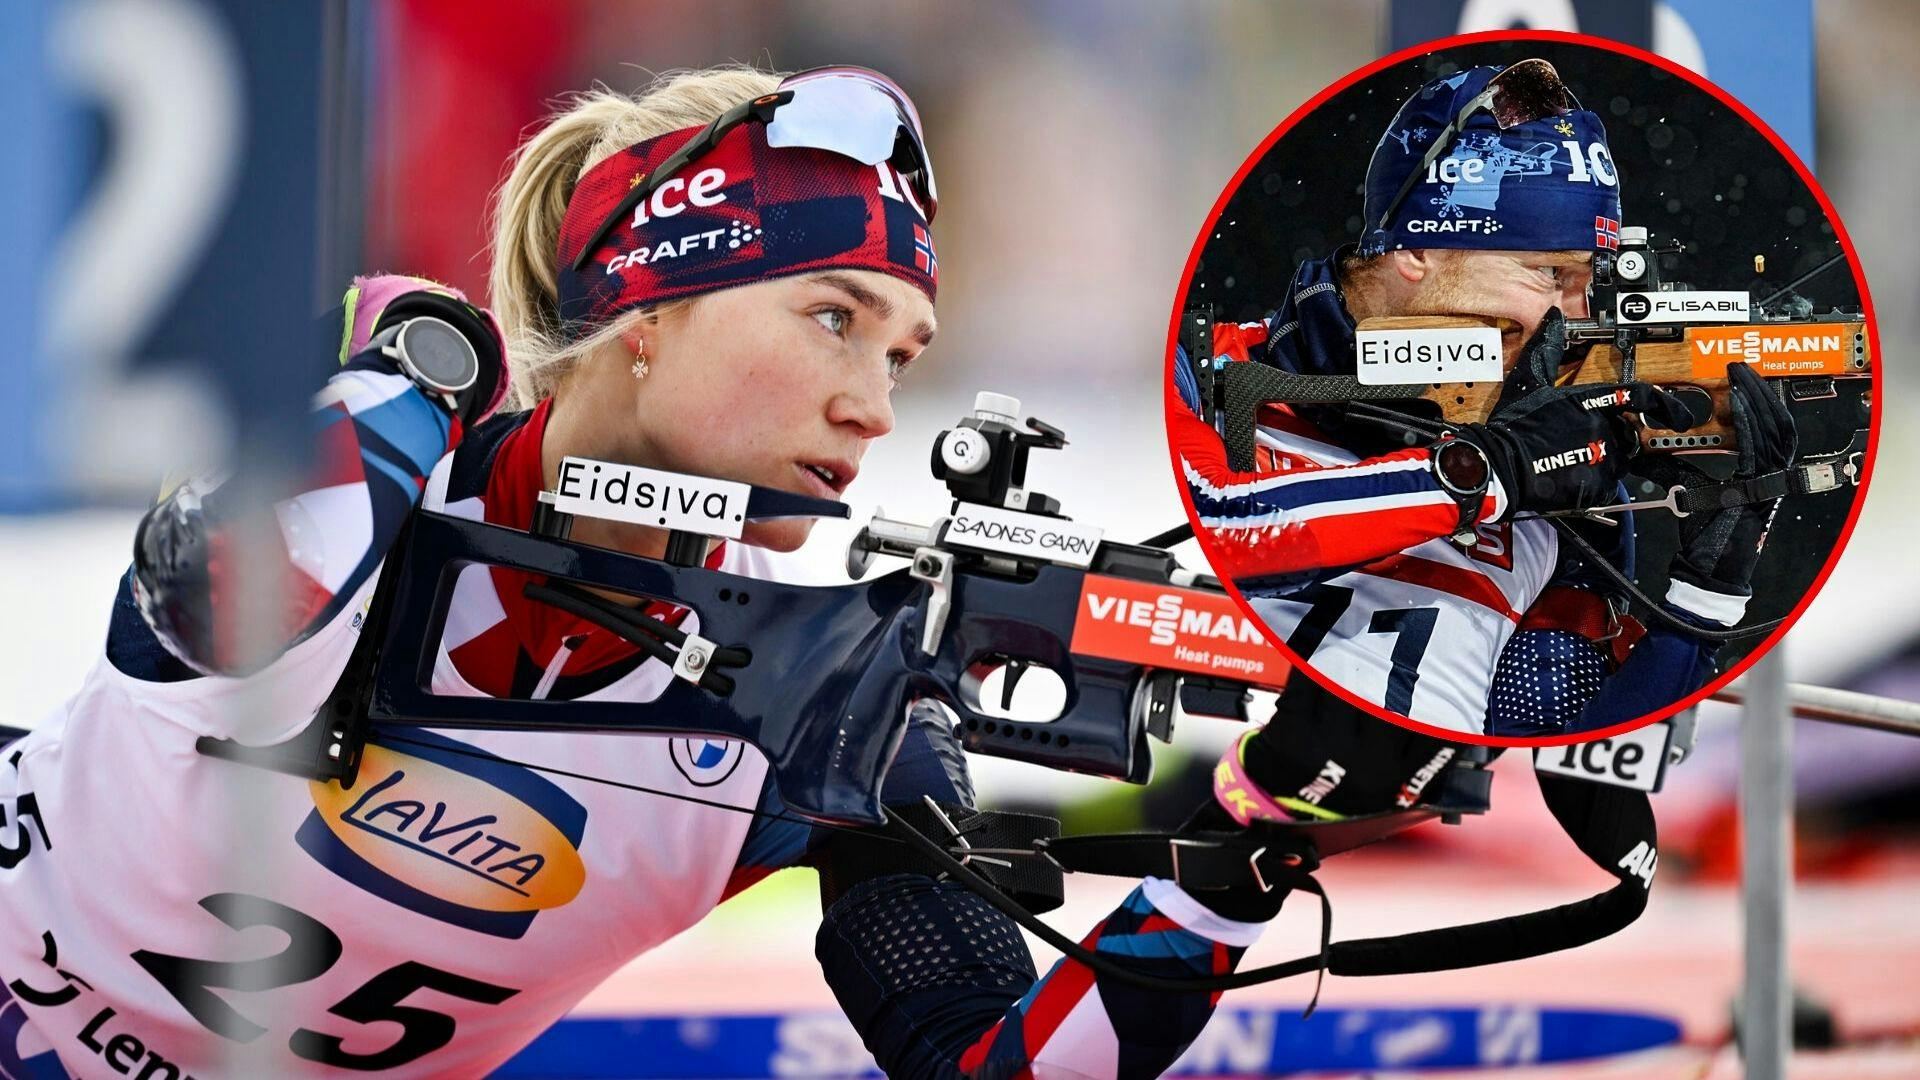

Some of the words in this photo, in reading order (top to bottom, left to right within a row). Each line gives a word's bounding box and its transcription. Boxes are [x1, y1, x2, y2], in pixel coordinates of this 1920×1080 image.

[1426, 157, 1484, 184] ice
[631, 168, 727, 229] ice
[1407, 219, 1482, 233] CRAFT
[606, 228, 726, 275] CRAFT
[1656, 301, 1747, 312] FLISABIL
[1696, 331, 1840, 364] VIESSMANN
[1763, 361, 1786, 370] Heat
[1789, 361, 1824, 371] pumps
[954, 517, 1036, 545] SANDNES
[1040, 532, 1094, 555] GARN
[1086, 593, 1274, 648] VIESSMAN
[1174, 645, 1210, 664] Heat
[1212, 654, 1264, 673] pumps
[130, 892, 523, 1072] 25
[77, 1006, 199, 1080] Len
